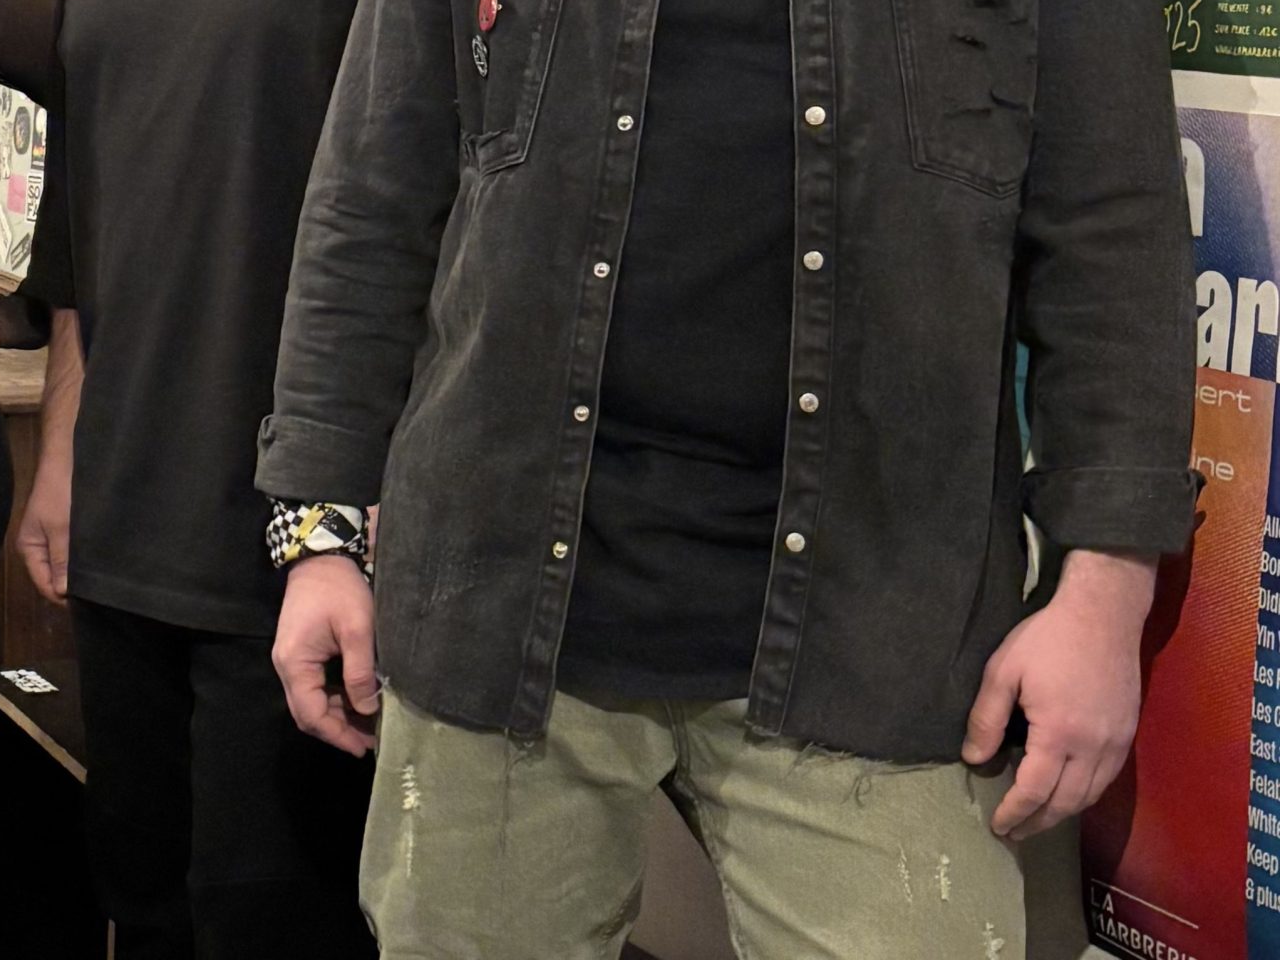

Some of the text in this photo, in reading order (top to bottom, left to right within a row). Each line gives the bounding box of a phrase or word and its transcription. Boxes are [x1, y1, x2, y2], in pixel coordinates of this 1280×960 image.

[1195, 384, 1252, 413] ert
[1263, 514, 1280, 539] All
[1253, 660, 1274, 688] Les
[1251, 696, 1272, 724] Les
[1250, 733, 1277, 763] East
[1246, 841, 1279, 876] Keep
[1090, 885, 1114, 915] LA
[1245, 877, 1255, 901] &
[1091, 910, 1199, 960] MARBRER
